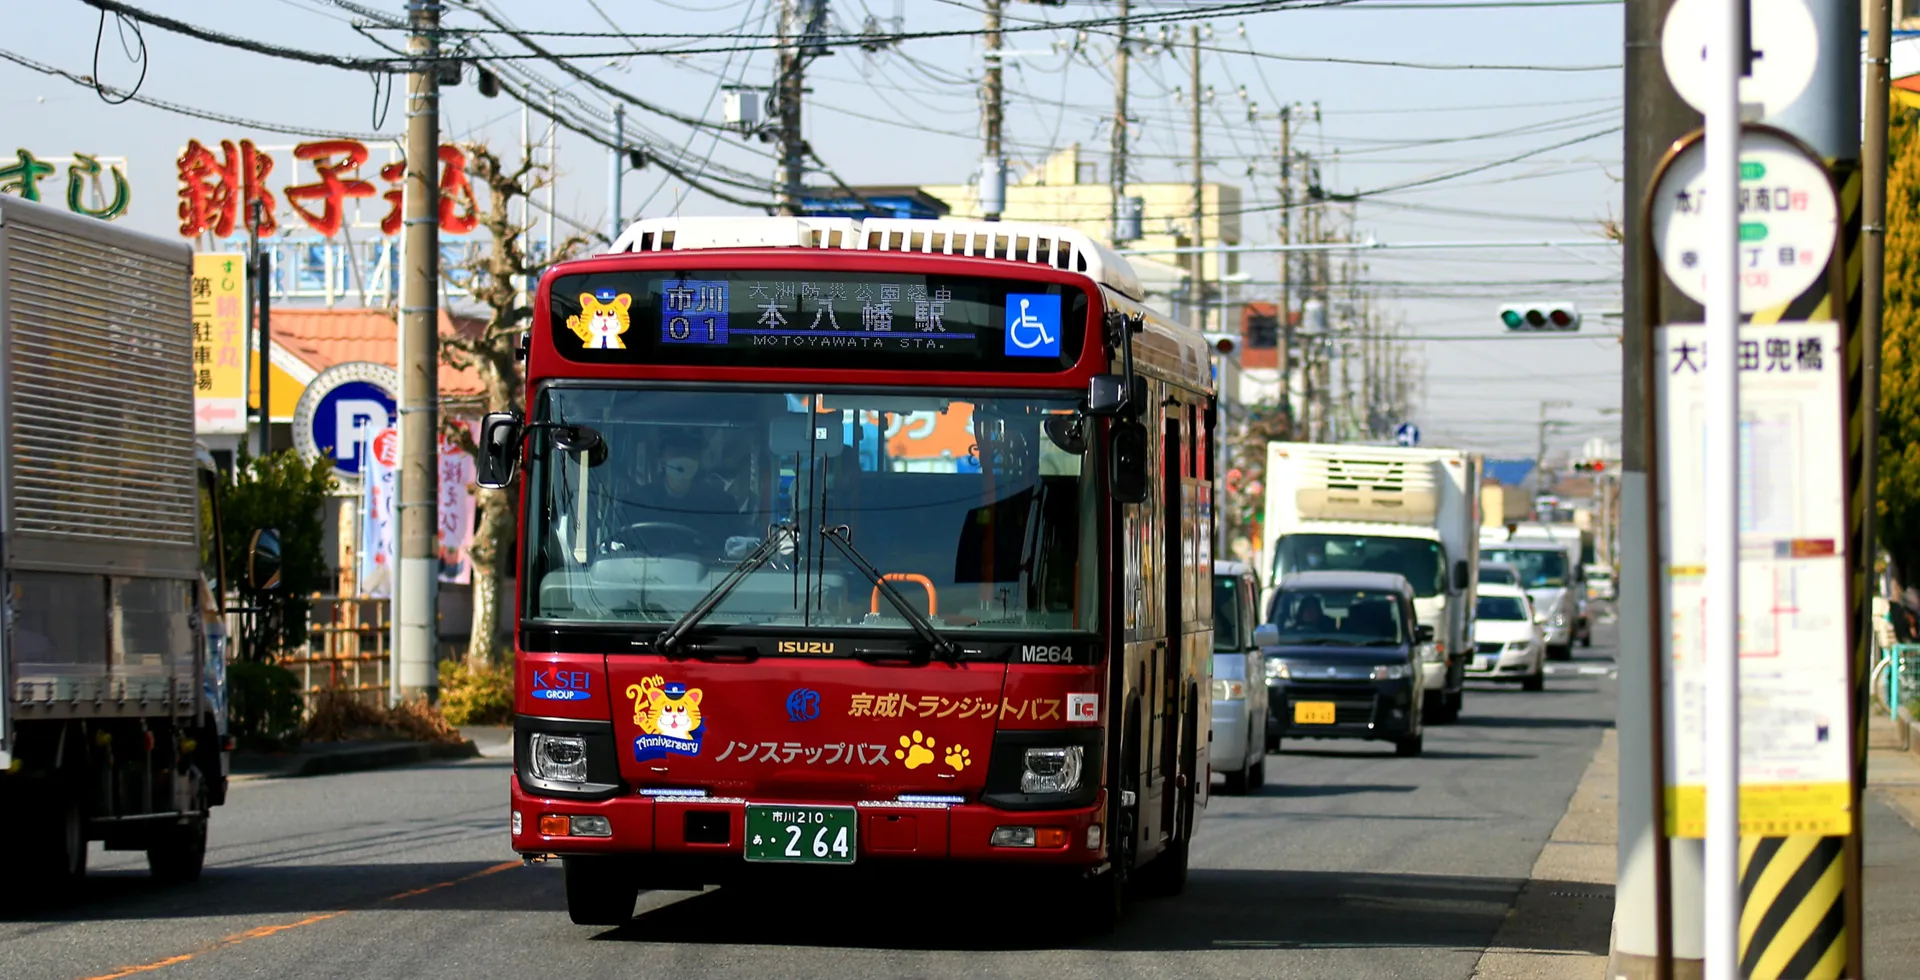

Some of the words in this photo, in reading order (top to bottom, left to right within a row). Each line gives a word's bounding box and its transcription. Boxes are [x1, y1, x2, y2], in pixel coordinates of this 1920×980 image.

[666, 286, 723, 312] 市川
[757, 298, 946, 333] 本八幡駅
[669, 317, 716, 340] 01
[753, 336, 884, 348] MOTOYAWATA
[900, 338, 944, 349] STA.
[1672, 338, 1823, 374] 大田兜橋
[336, 400, 387, 459] P
[778, 641, 834, 654] ISUZU
[1021, 645, 1074, 663] M264
[546, 690, 574, 700] GROUP
[848, 692, 1061, 721] 京成トランジットバス
[636, 736, 699, 754] Anniversary
[715, 740, 890, 766] ノンステップバス
[752, 834, 763, 846] あ
